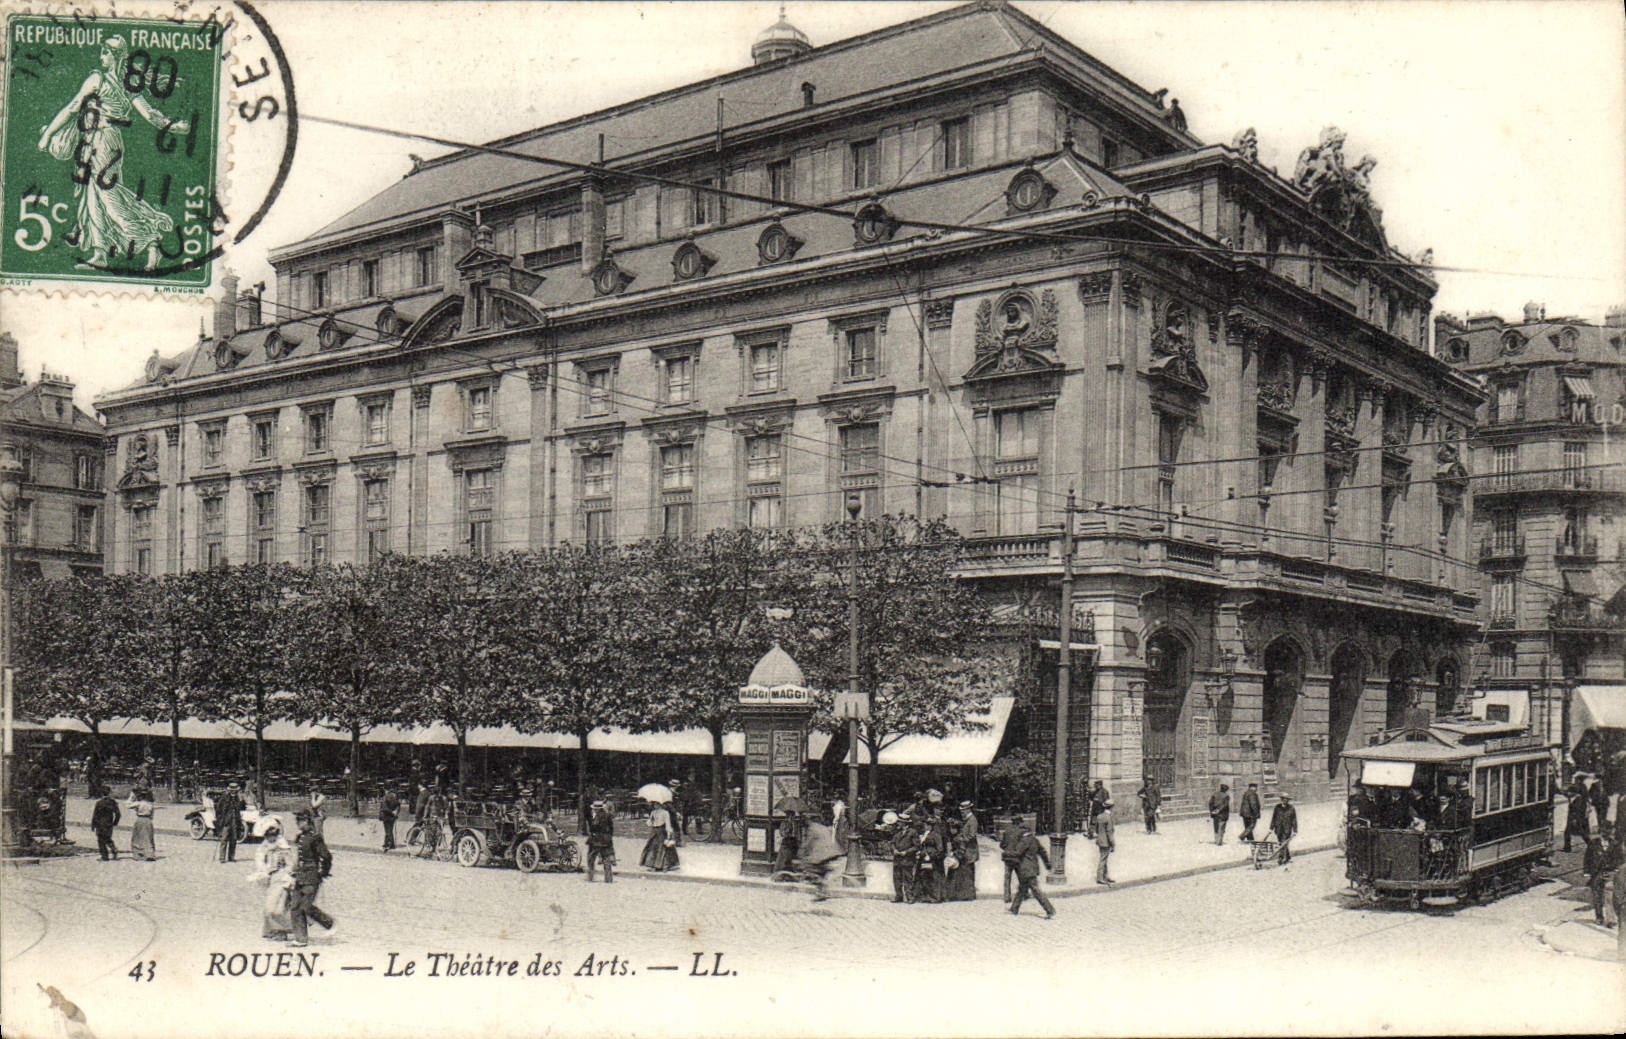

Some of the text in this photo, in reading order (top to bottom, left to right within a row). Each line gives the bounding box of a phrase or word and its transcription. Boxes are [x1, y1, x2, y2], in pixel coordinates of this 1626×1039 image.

[131, 29, 213, 52] FRANÇAISE
[740, 689, 768, 699] MAGGI
[771, 688, 806, 699] MAGGI
